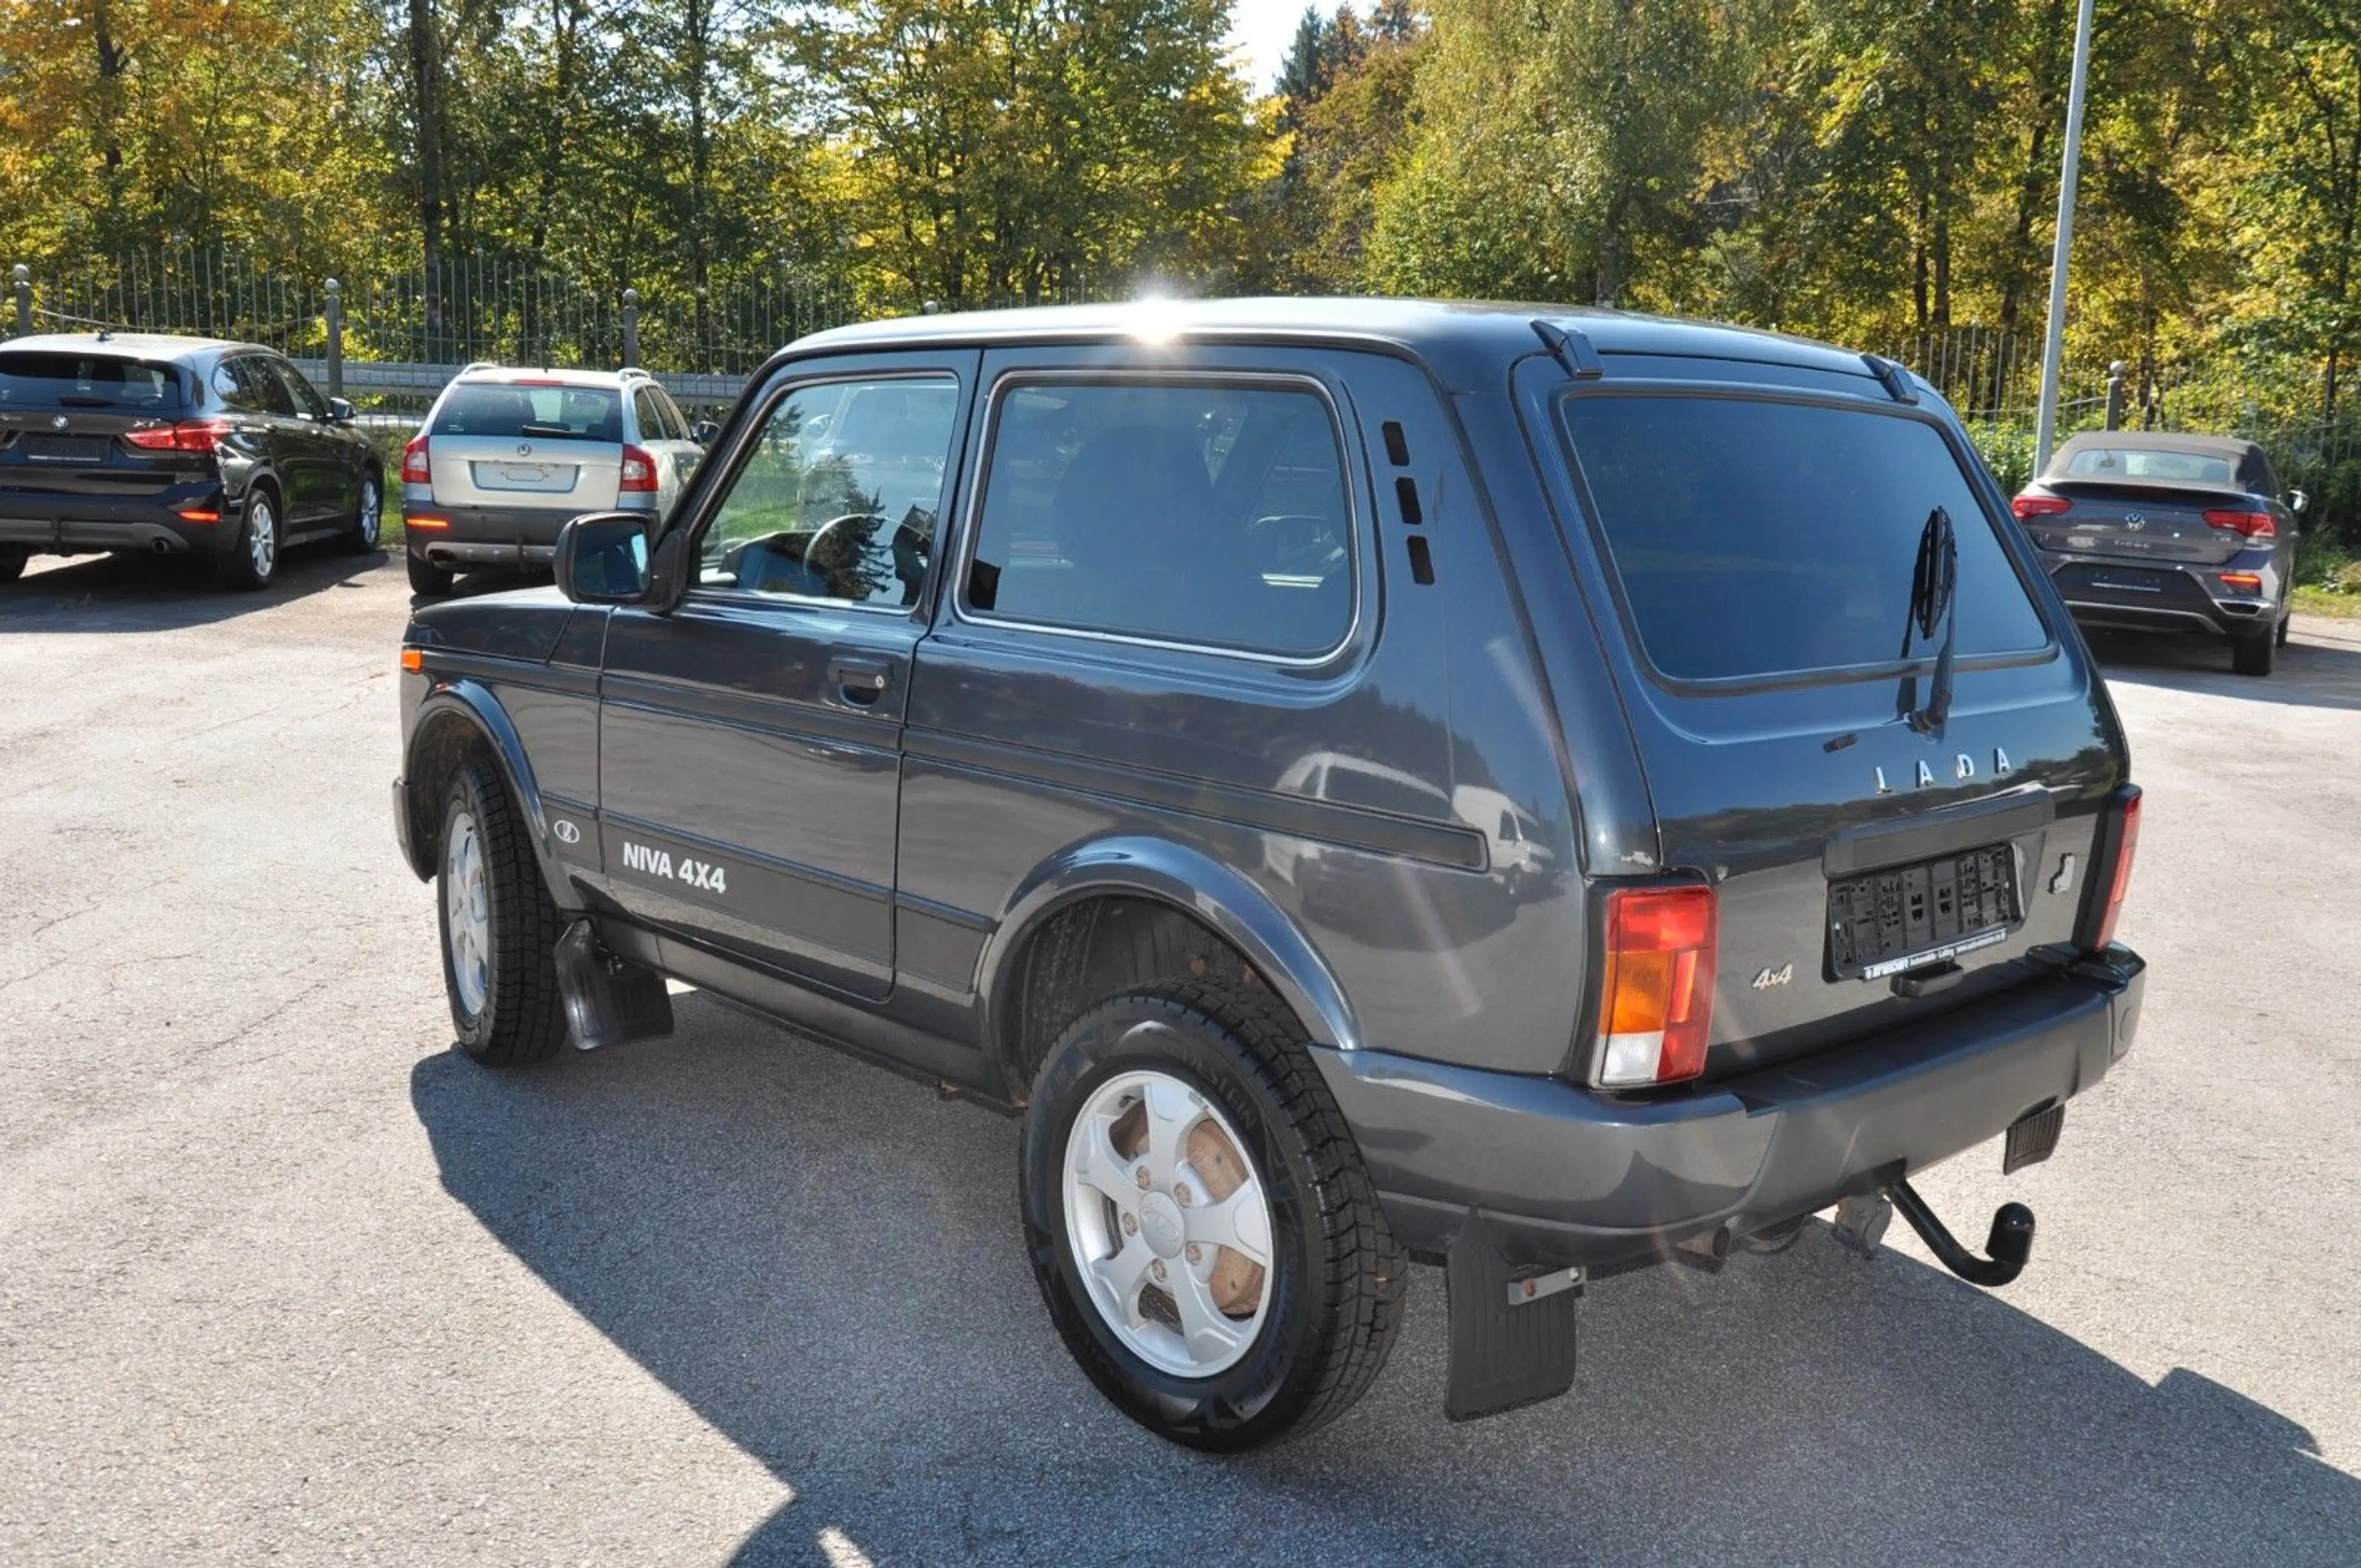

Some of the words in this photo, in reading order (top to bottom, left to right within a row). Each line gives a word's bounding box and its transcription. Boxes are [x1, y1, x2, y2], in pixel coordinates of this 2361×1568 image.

[1875, 747, 2011, 795] LADA
[623, 841, 673, 880] NIVA
[678, 858, 727, 894] 4X4
